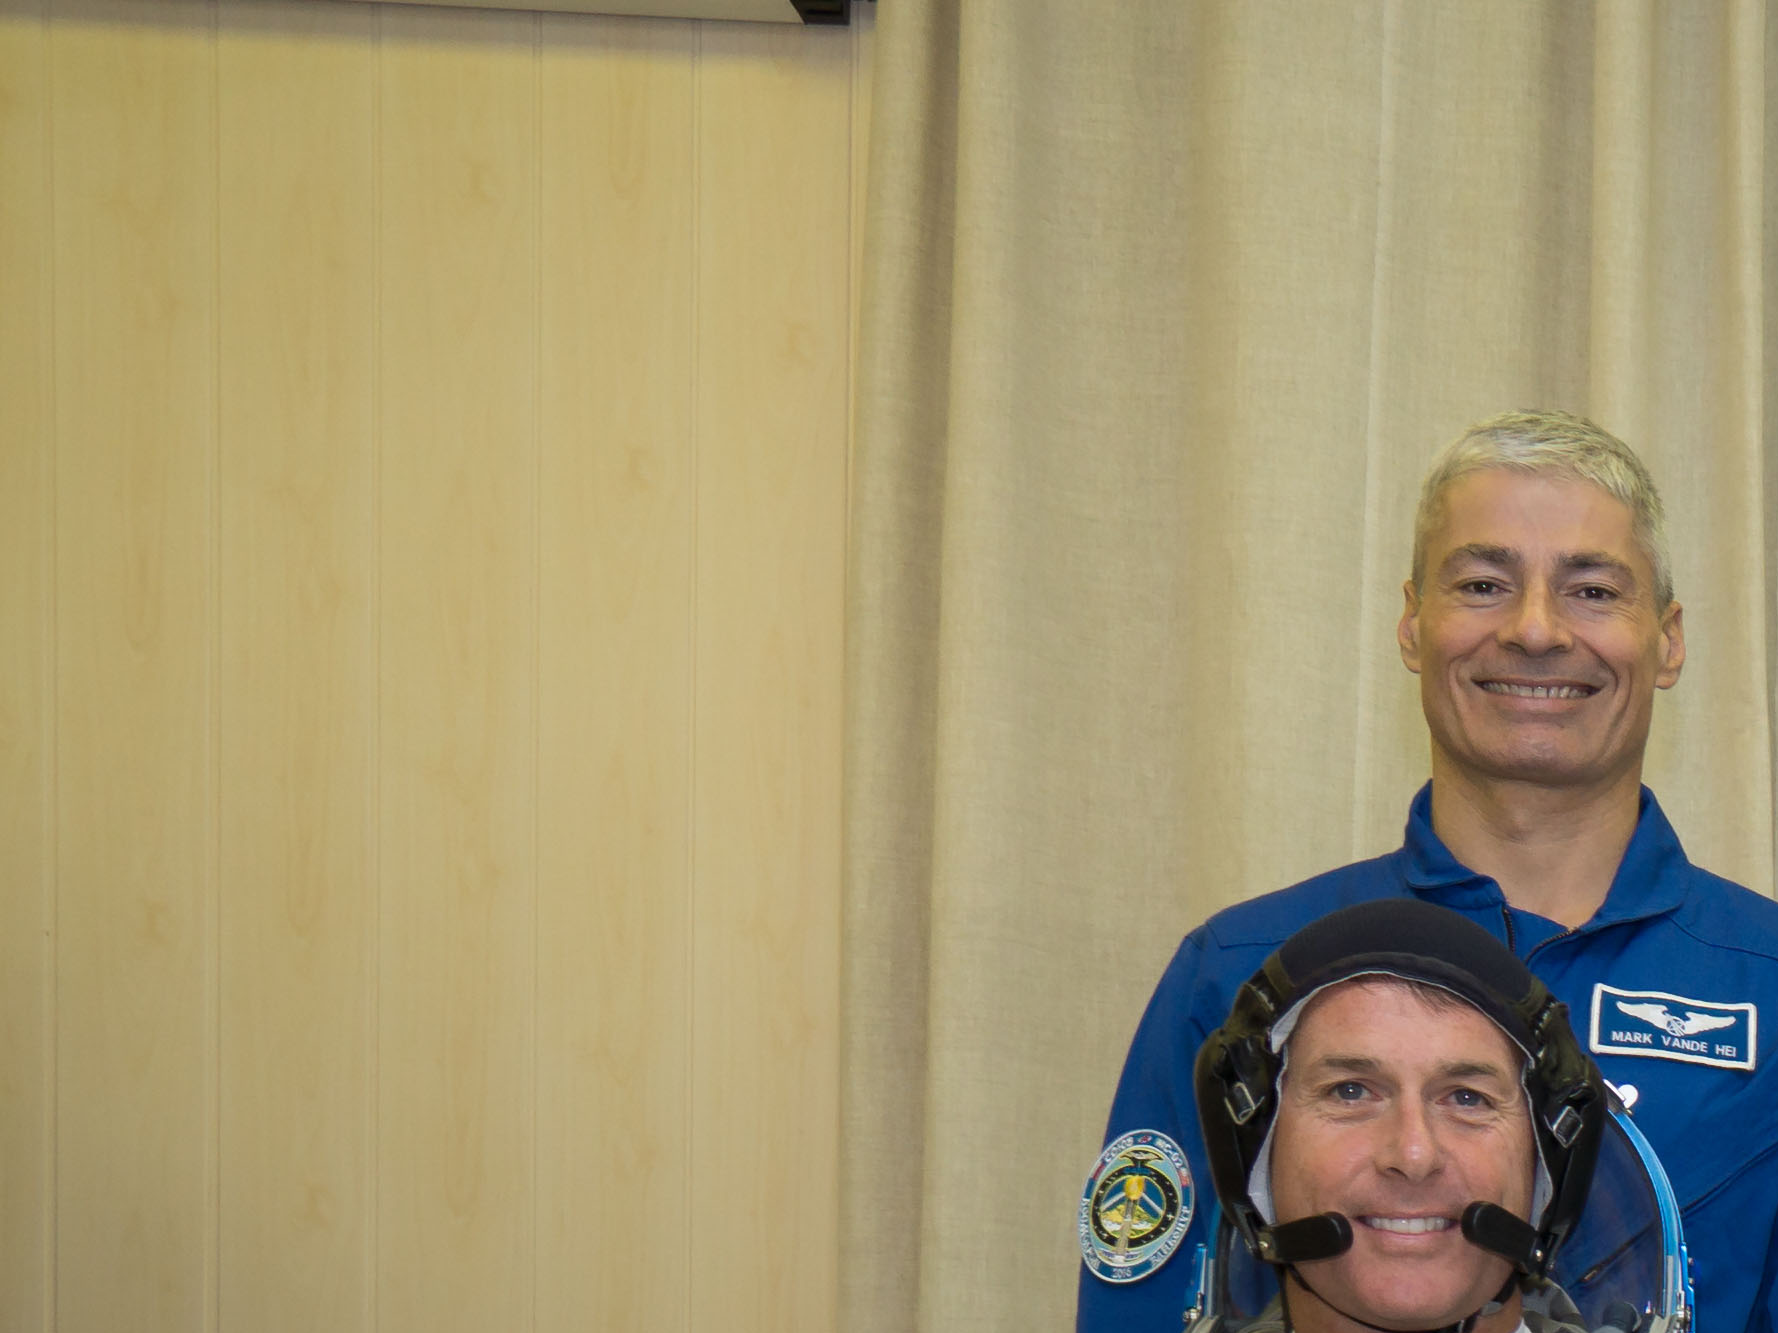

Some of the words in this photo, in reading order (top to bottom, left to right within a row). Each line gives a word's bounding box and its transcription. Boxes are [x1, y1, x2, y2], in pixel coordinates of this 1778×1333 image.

[1611, 1031, 1652, 1044] MARK
[1661, 1035, 1708, 1053] VANDE
[1715, 1044, 1737, 1057] HEI
